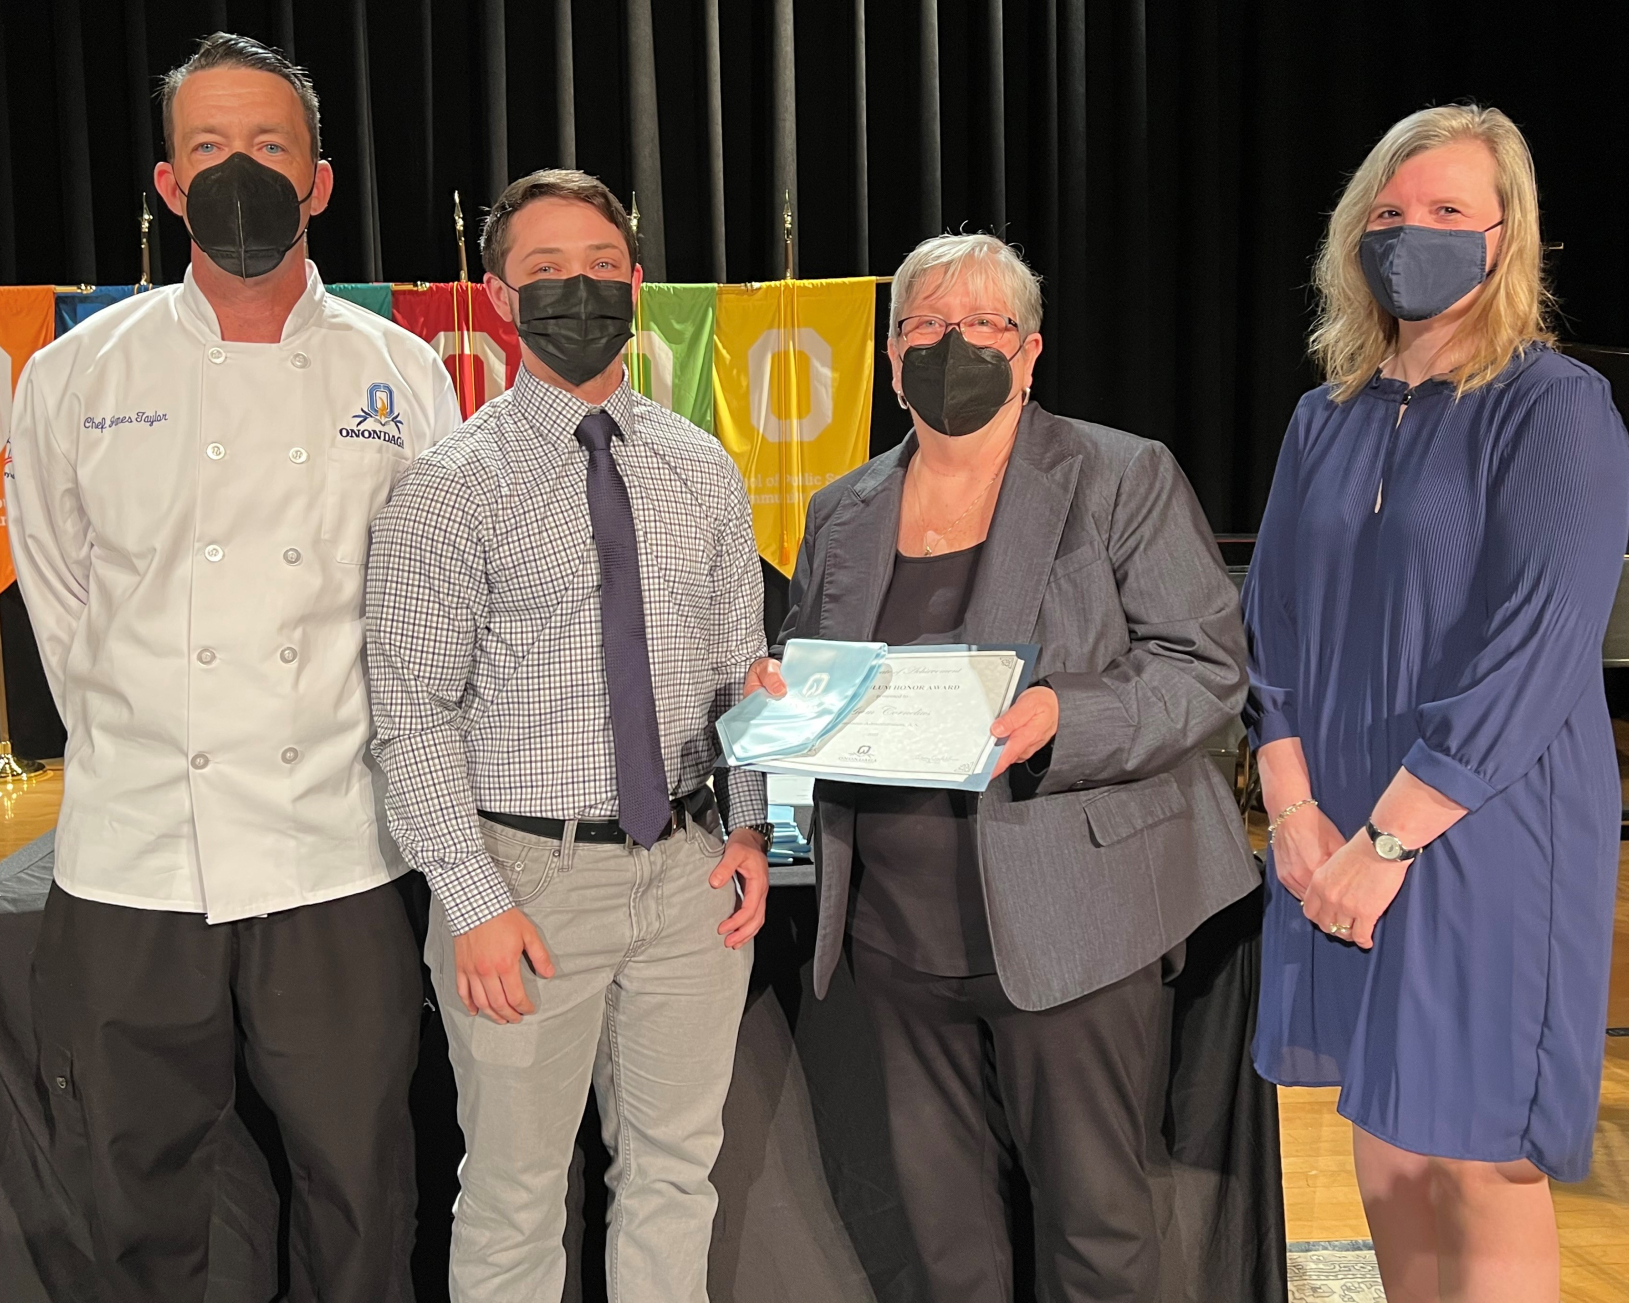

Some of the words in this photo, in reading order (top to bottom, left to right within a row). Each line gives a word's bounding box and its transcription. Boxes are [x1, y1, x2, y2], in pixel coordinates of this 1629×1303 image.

[83, 417, 106, 433] Chef
[135, 411, 168, 427] Taylor
[339, 427, 405, 449] ONONDAG
[766, 474, 780, 487] of
